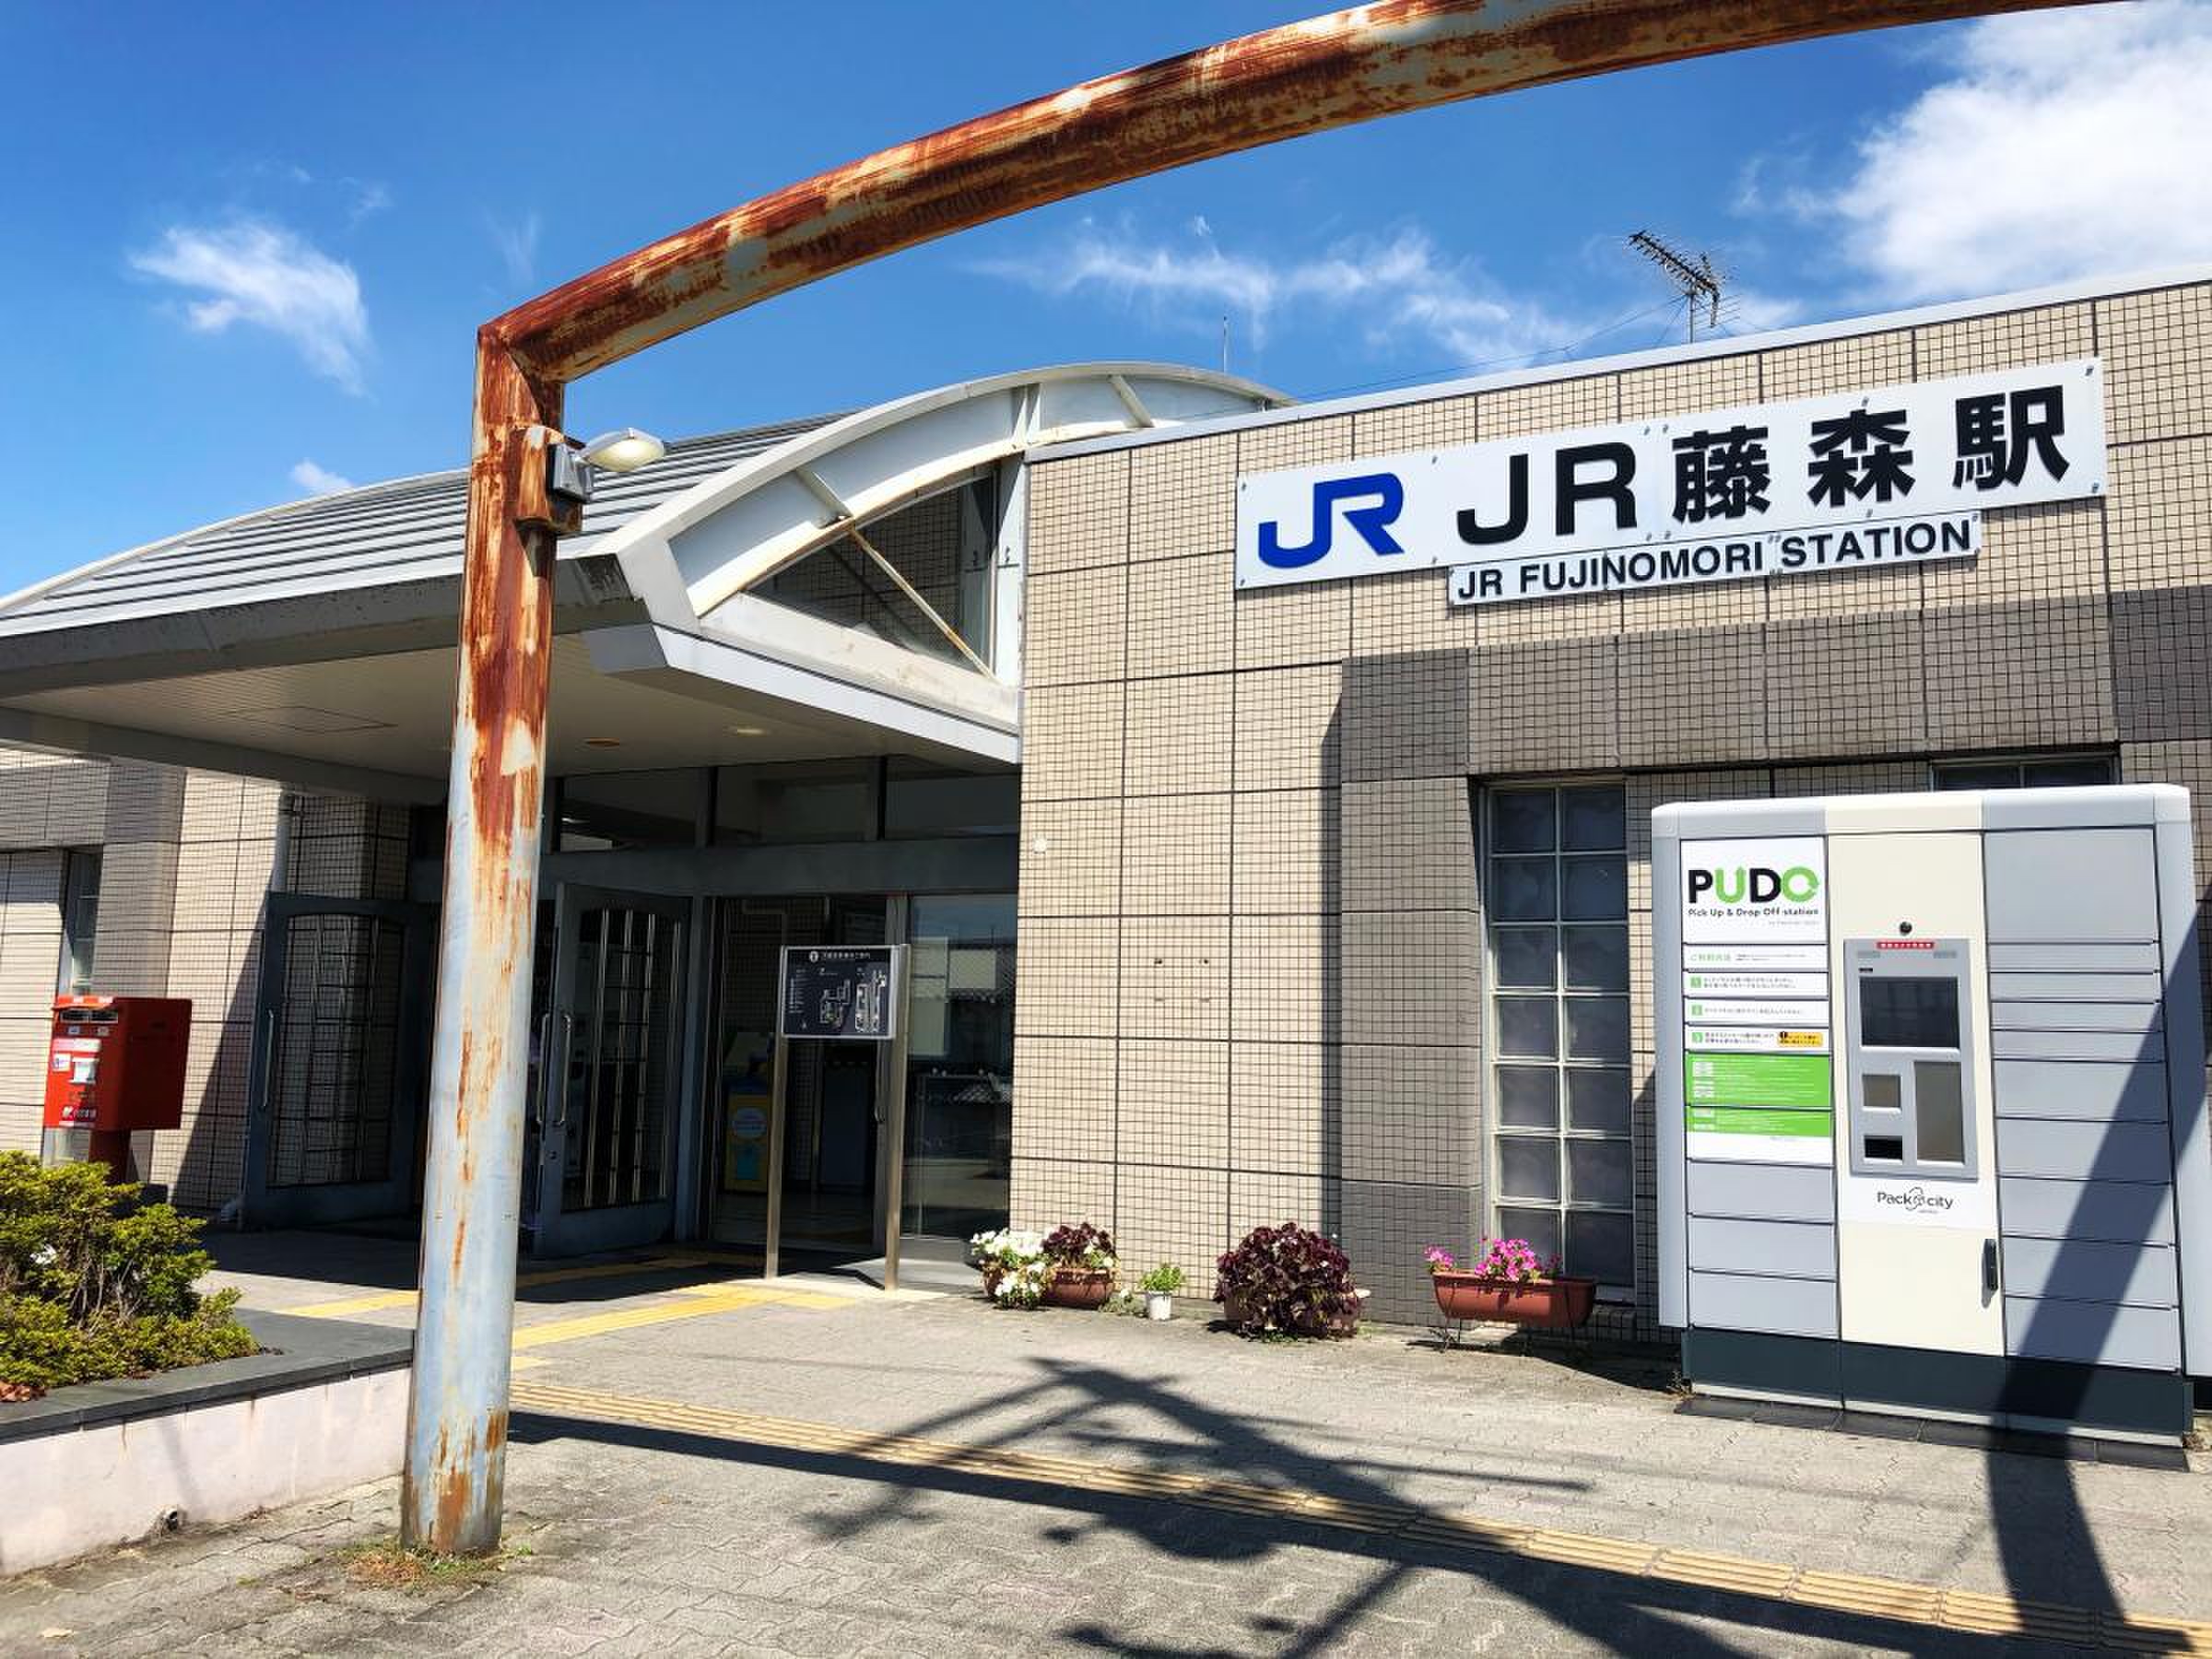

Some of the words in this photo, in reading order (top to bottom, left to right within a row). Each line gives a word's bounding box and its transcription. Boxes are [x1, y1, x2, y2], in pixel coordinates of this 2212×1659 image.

[1258, 472, 1405, 569] JR
[1458, 569, 1502, 599] JR
[1520, 540, 1762, 593] FUJINOMORI
[1781, 520, 1971, 569] STATION
[1688, 866, 1818, 903] PUDO
[1688, 908, 1707, 916] Pick
[1710, 908, 1724, 917] Up
[1736, 908, 1760, 918] Drop
[1763, 907, 1780, 915] Off
[1783, 907, 1818, 915] station
